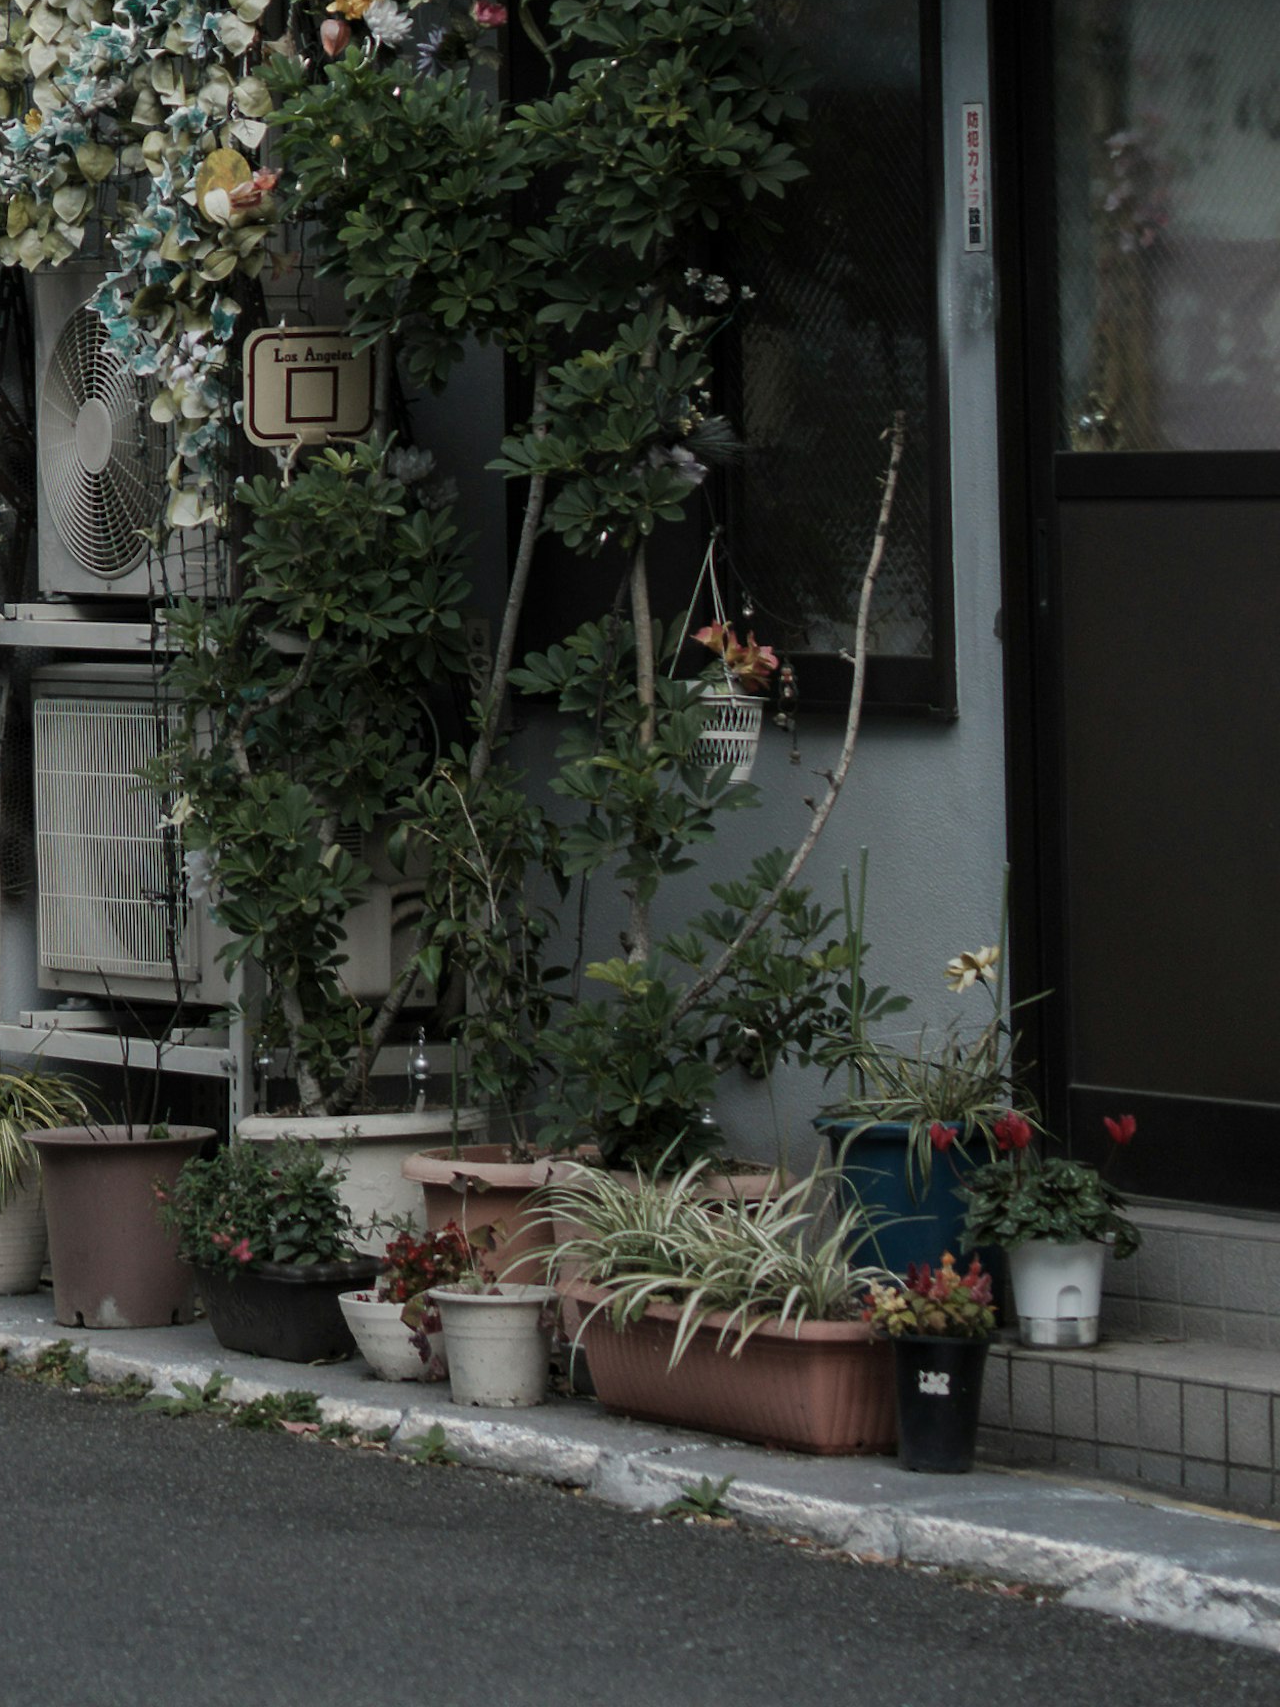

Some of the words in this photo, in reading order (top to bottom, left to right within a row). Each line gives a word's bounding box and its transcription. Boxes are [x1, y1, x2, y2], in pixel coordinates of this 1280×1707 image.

[966, 111, 981, 244] 防犯カメラ設置
[273, 347, 298, 363] Los
